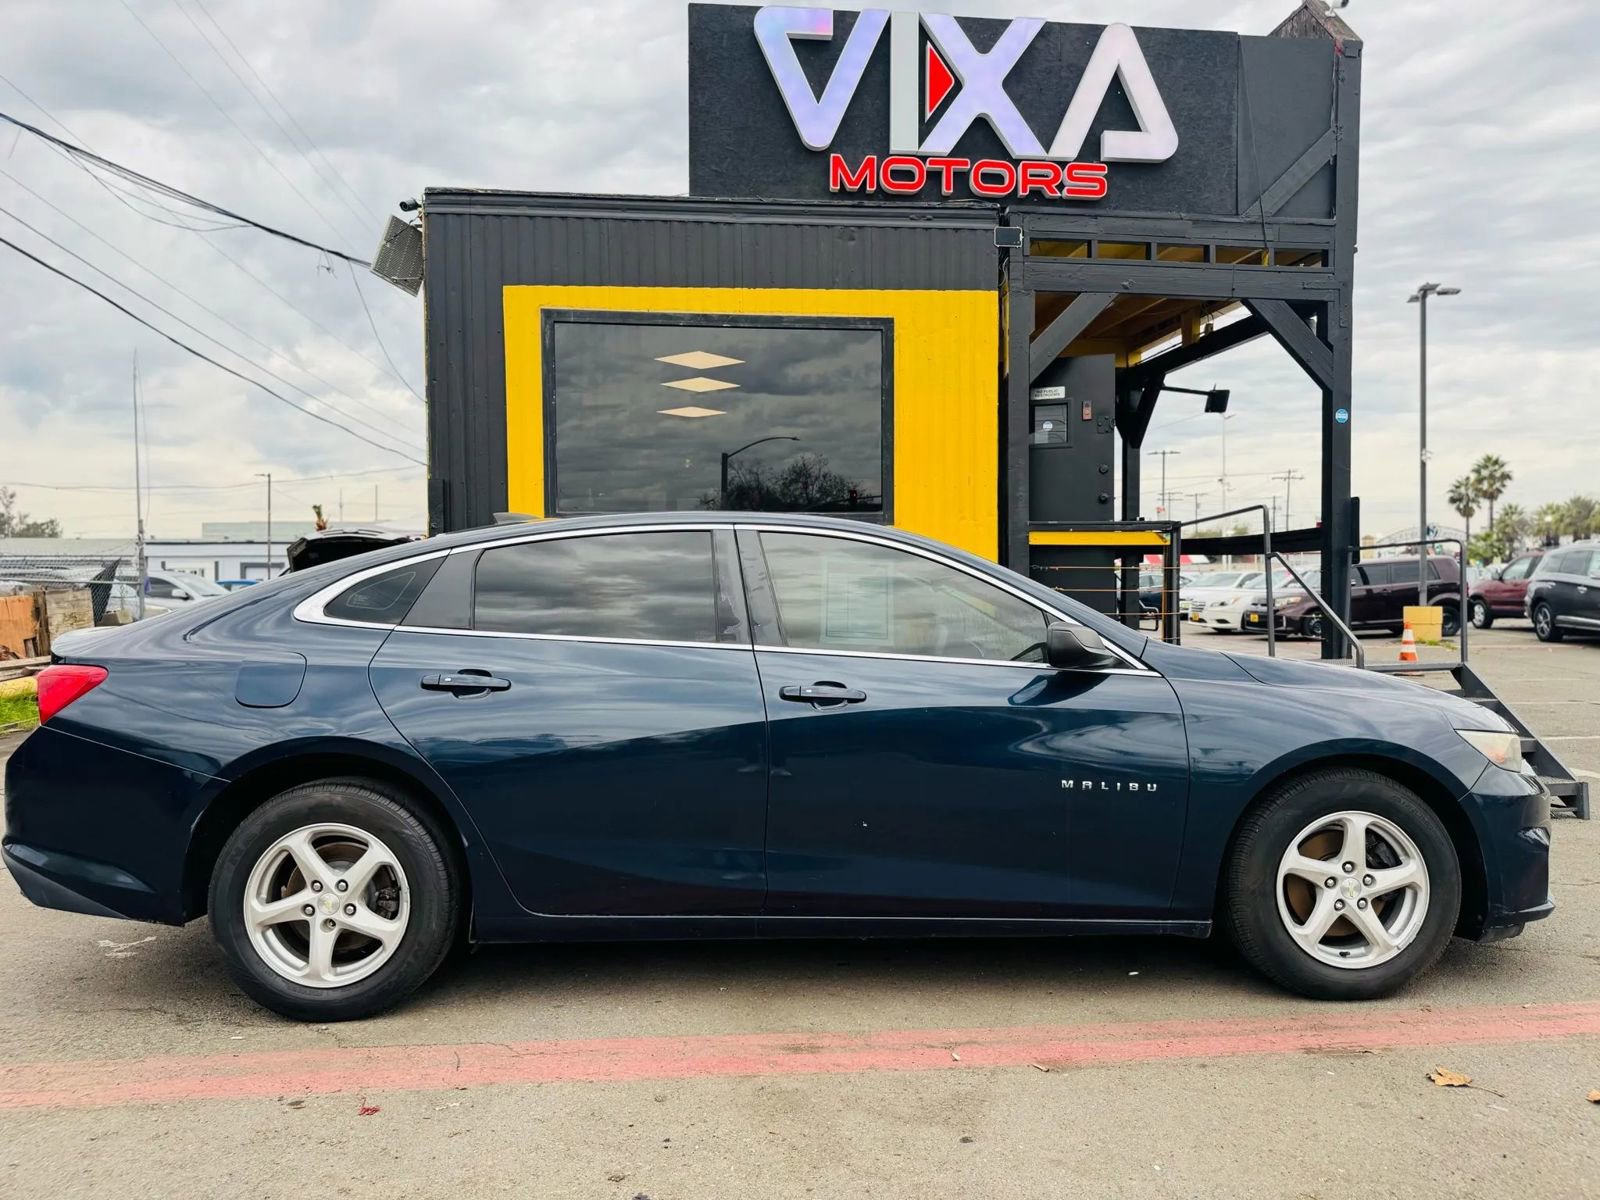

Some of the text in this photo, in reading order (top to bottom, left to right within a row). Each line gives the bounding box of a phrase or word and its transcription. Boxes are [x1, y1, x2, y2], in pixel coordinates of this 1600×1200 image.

[753, 6, 1179, 162] VIXA
[829, 154, 1108, 199] MOTORS
[1061, 779, 1157, 791] MALIBU
